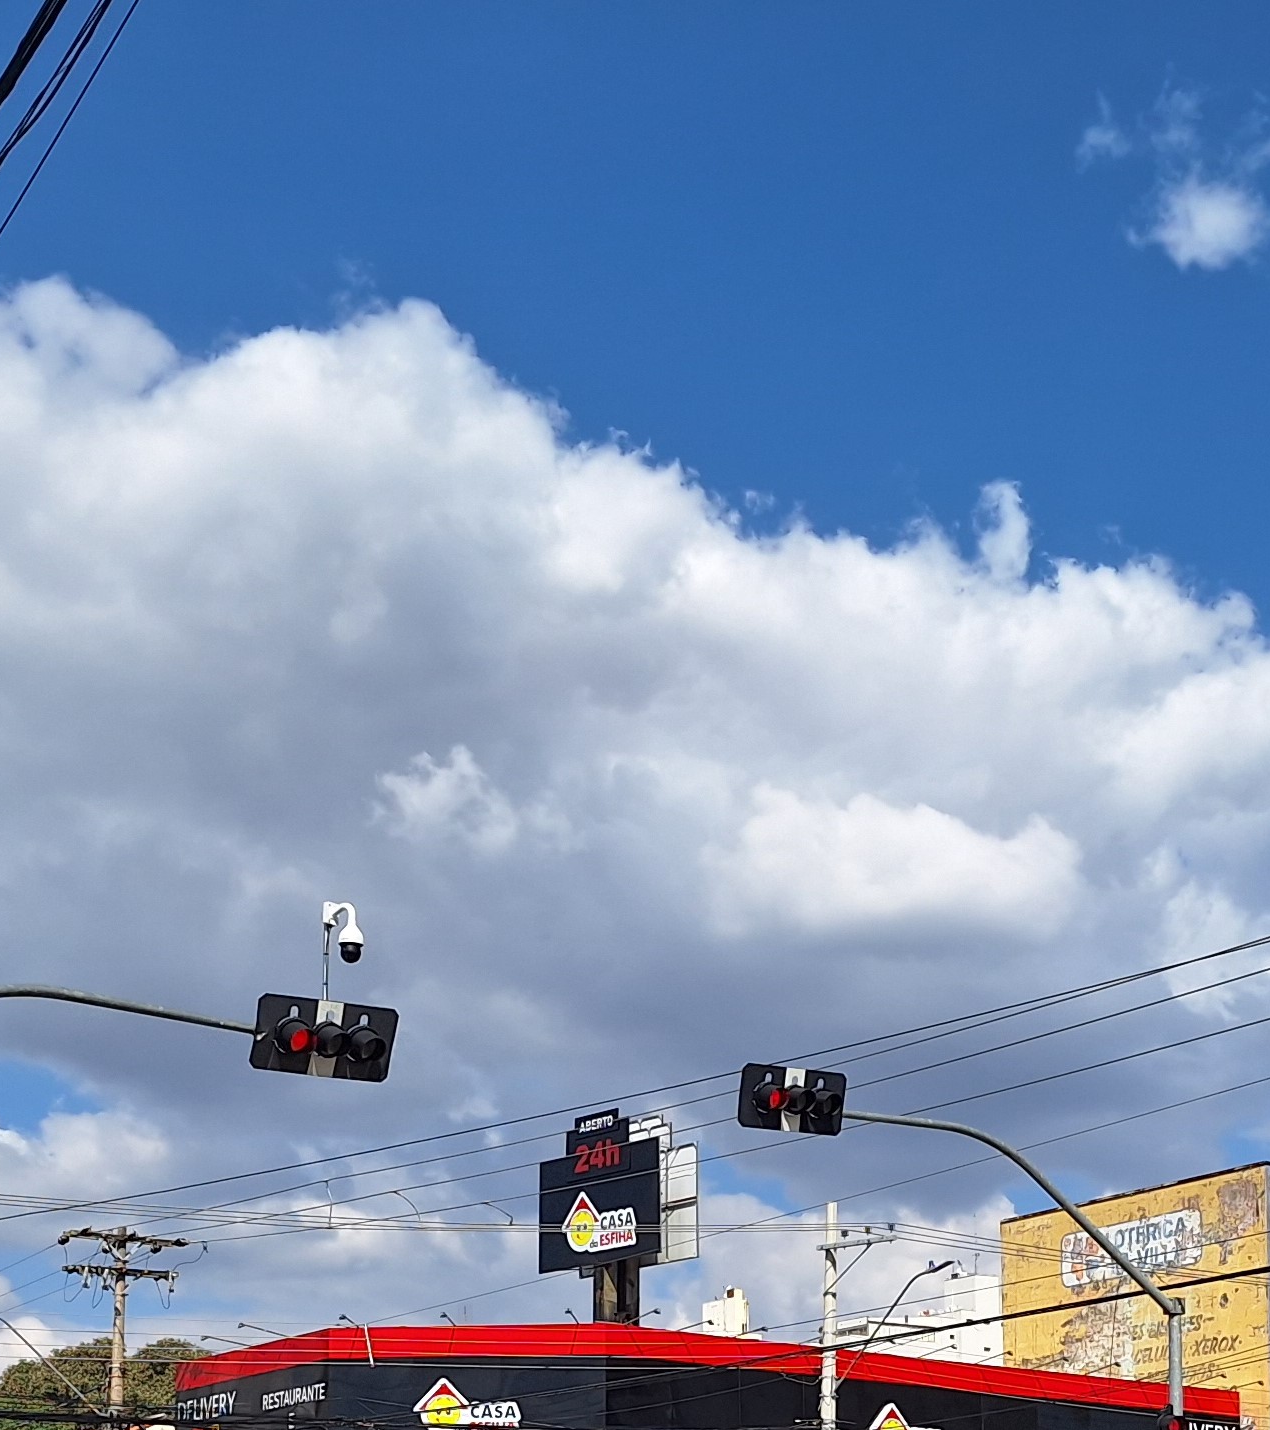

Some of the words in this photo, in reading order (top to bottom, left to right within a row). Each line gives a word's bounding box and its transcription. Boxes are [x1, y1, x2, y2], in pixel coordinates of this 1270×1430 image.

[579, 1115, 614, 1134] ABERTO
[574, 1138, 621, 1174] 24h
[600, 1212, 634, 1230] CASA
[599, 1231, 633, 1246] ESFIHA
[263, 1383, 326, 1411] RESTAURANTE
[471, 1405, 517, 1418] CASA
